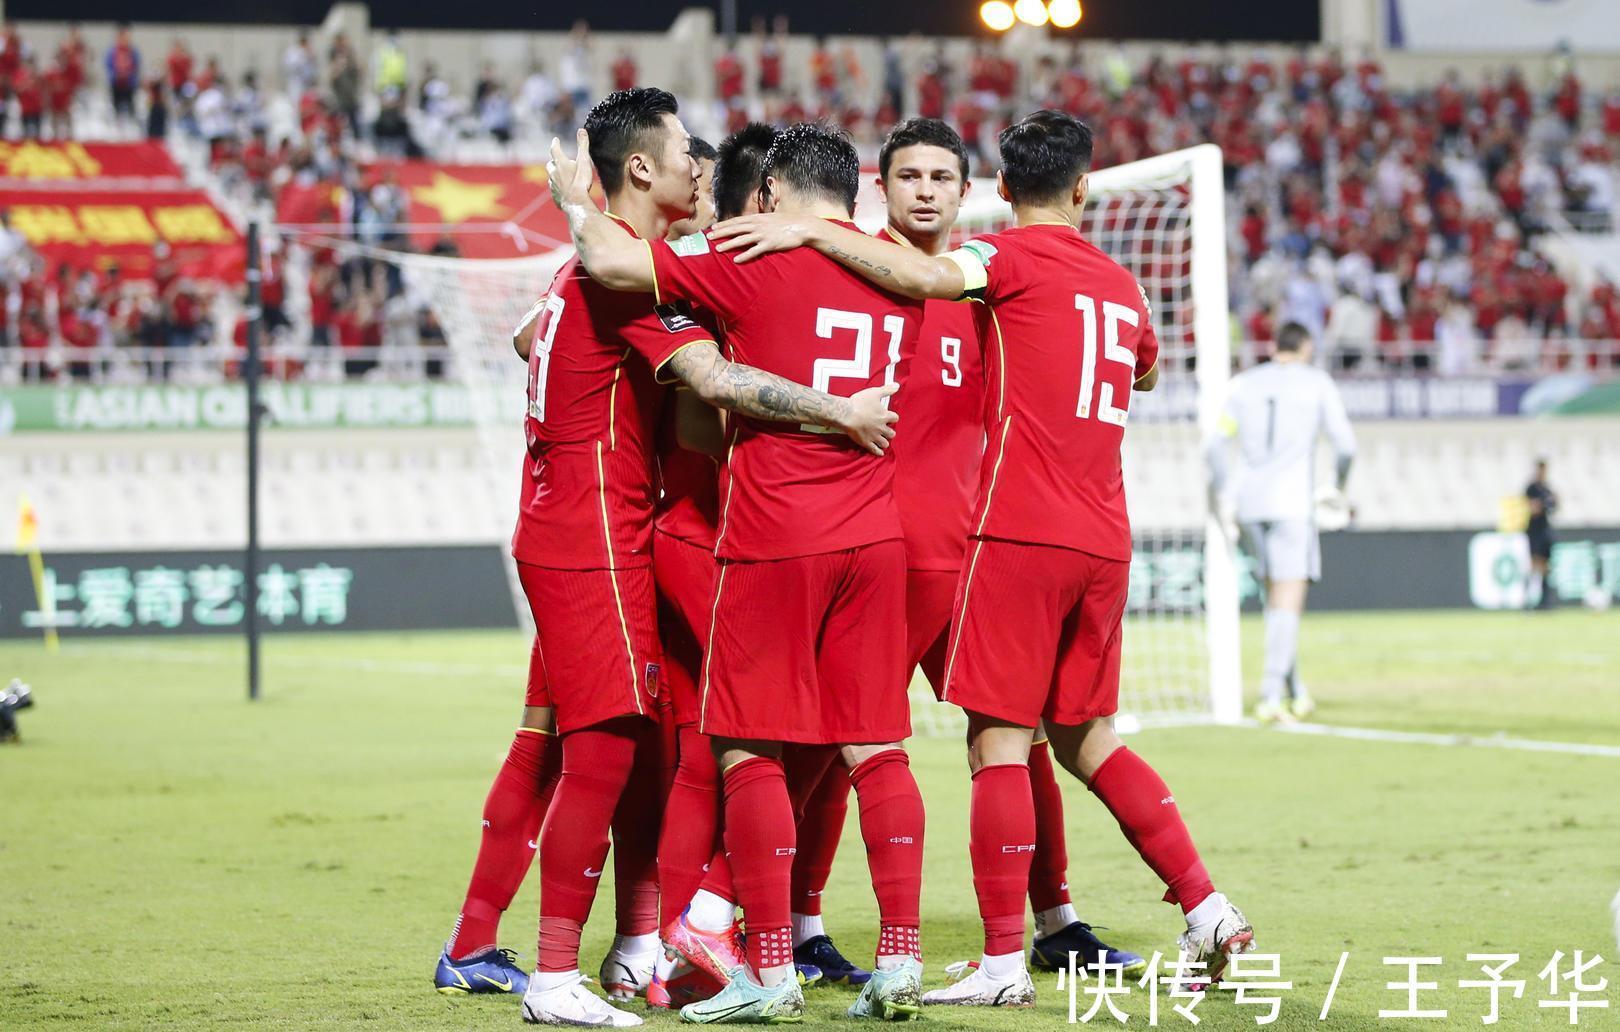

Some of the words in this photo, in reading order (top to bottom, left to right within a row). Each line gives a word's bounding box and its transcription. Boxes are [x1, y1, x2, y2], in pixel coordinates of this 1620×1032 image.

[801, 307, 905, 434] 21
[940, 326, 963, 388] 9
[1074, 293, 1140, 428] 15
[1264, 396, 1278, 452] 1
